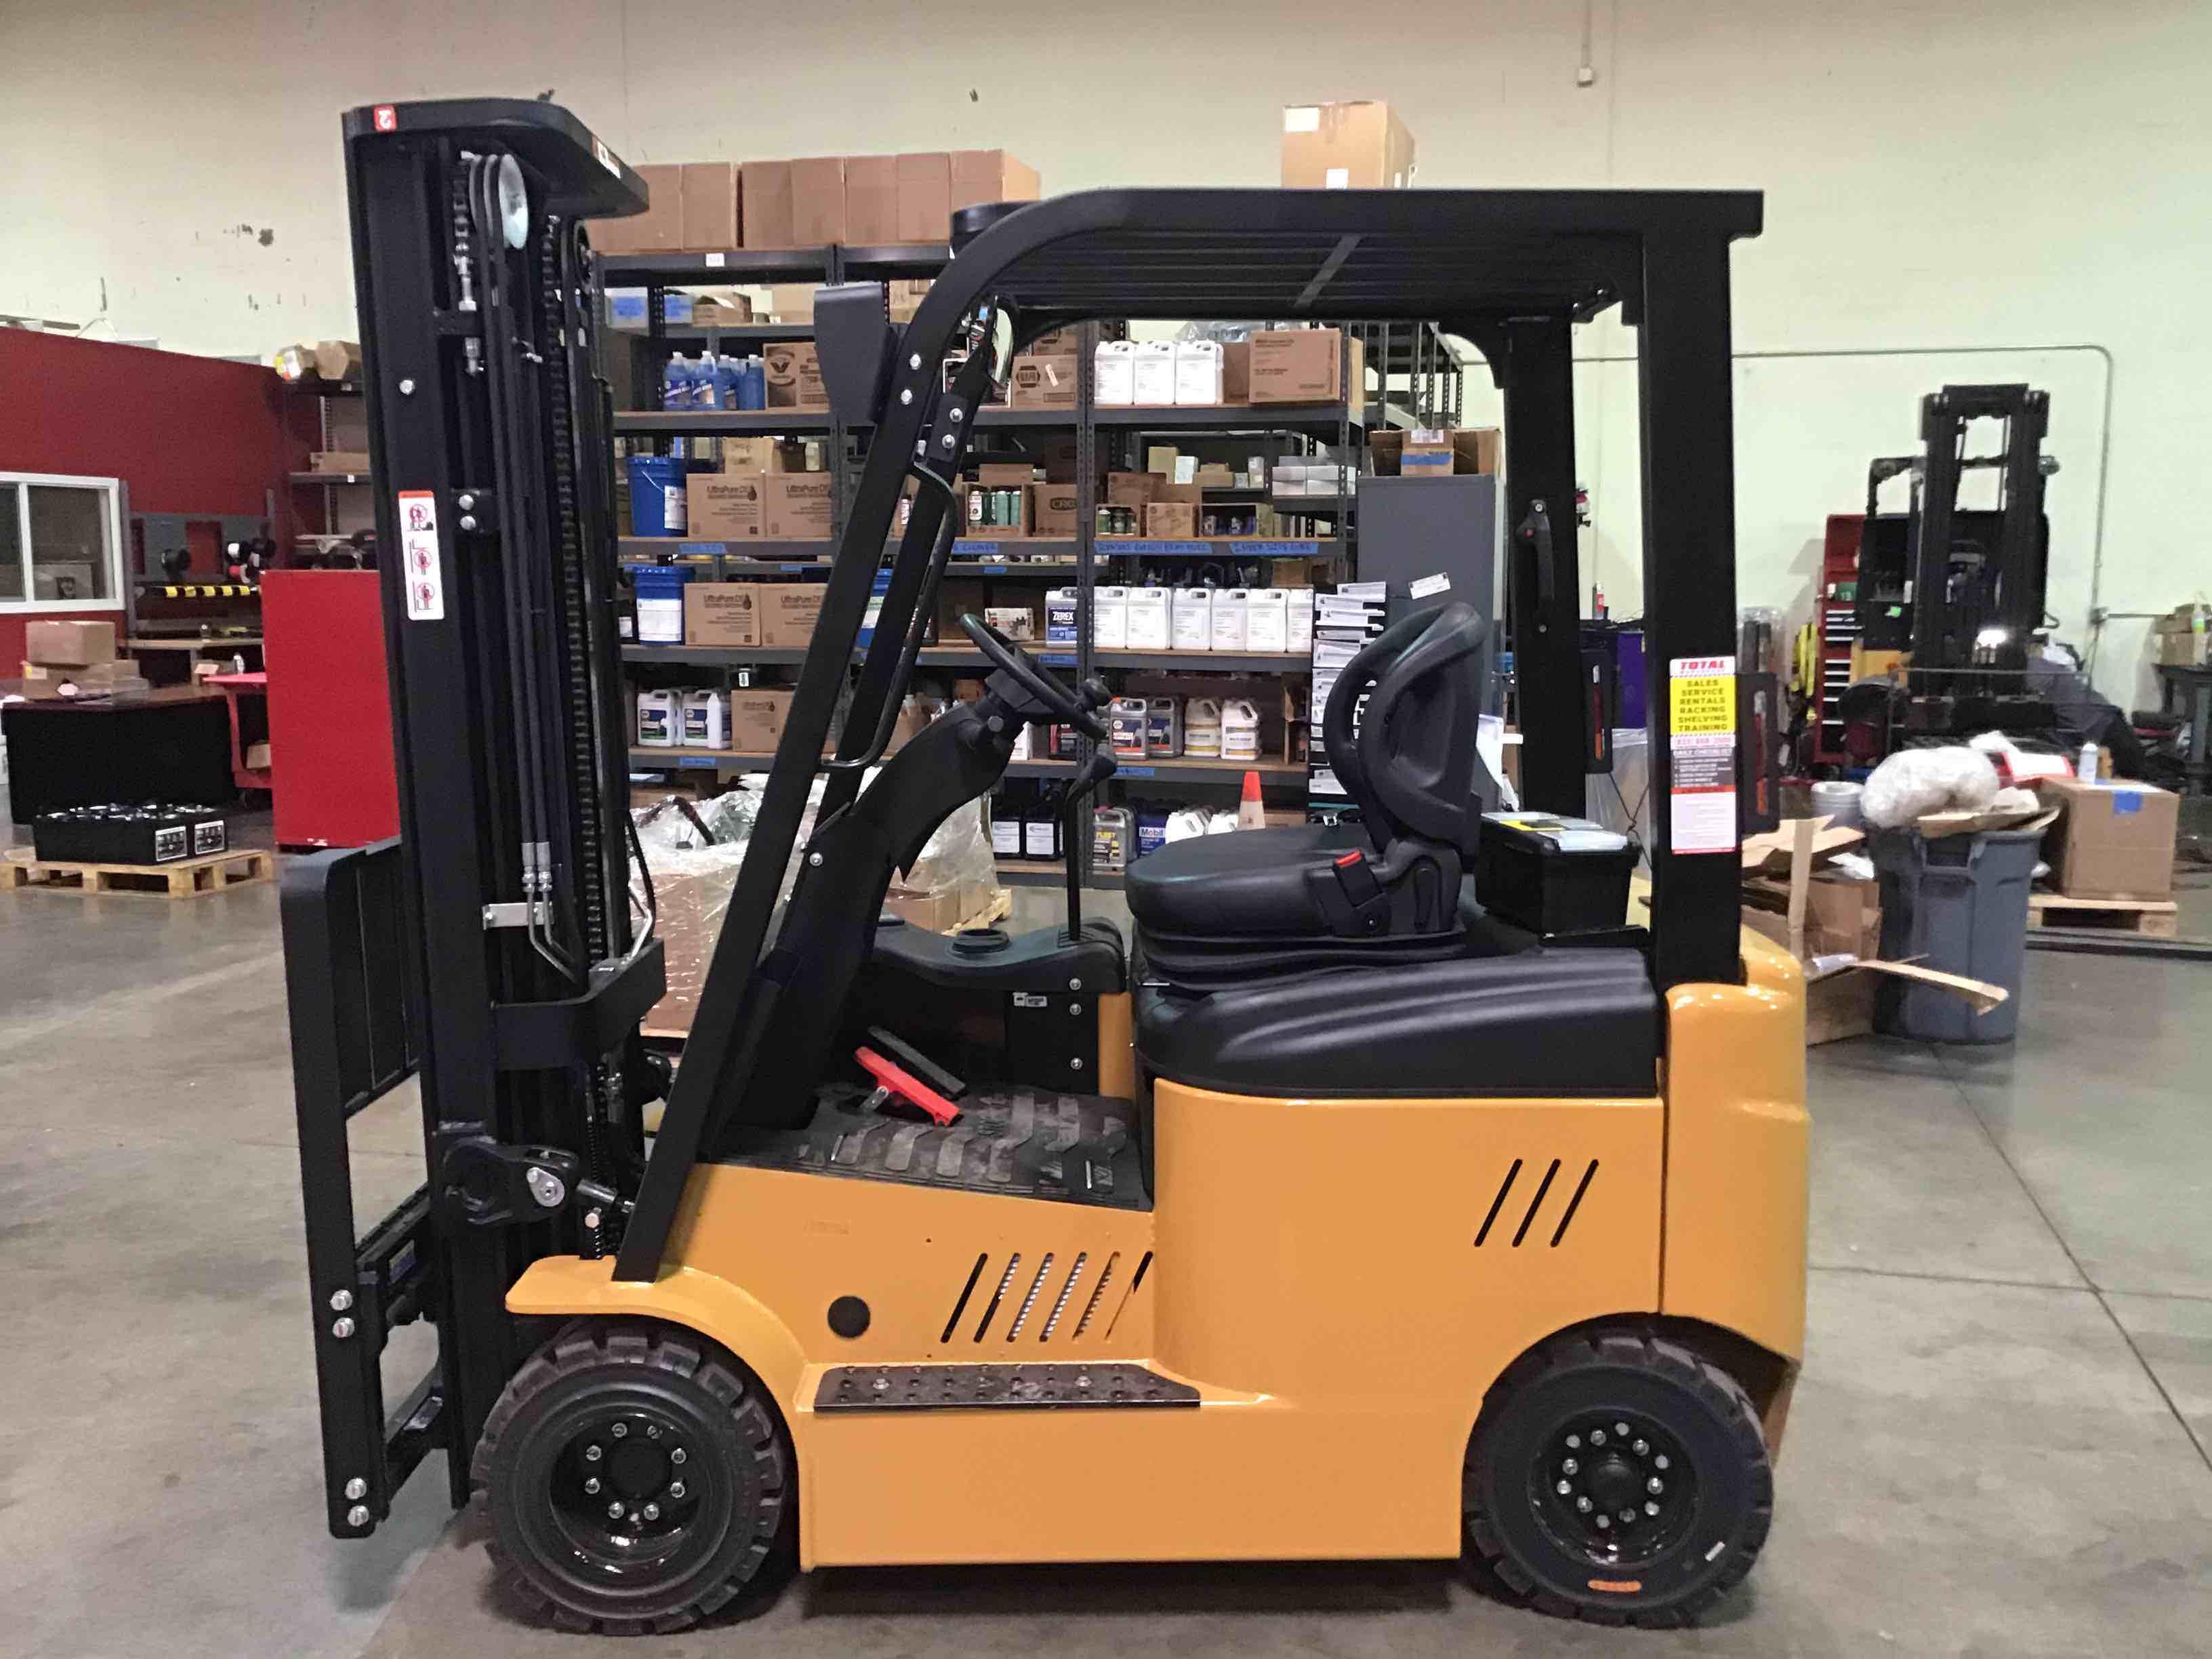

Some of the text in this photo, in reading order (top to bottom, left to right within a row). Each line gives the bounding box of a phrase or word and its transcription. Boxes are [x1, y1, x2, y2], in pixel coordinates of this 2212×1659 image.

[1052, 611, 1074, 621] ZEREX
[1680, 661, 1724, 670] TOTAL
[1686, 679, 1719, 687] SALES
[1681, 688, 1724, 697] SERVICE
[1679, 697, 1726, 705] RENTALS
[1679, 705, 1726, 714] RACKING
[1678, 714, 1728, 723] SHELVING
[1678, 724, 1728, 732] TRAINING
[1141, 828, 1164, 836] Mobil
